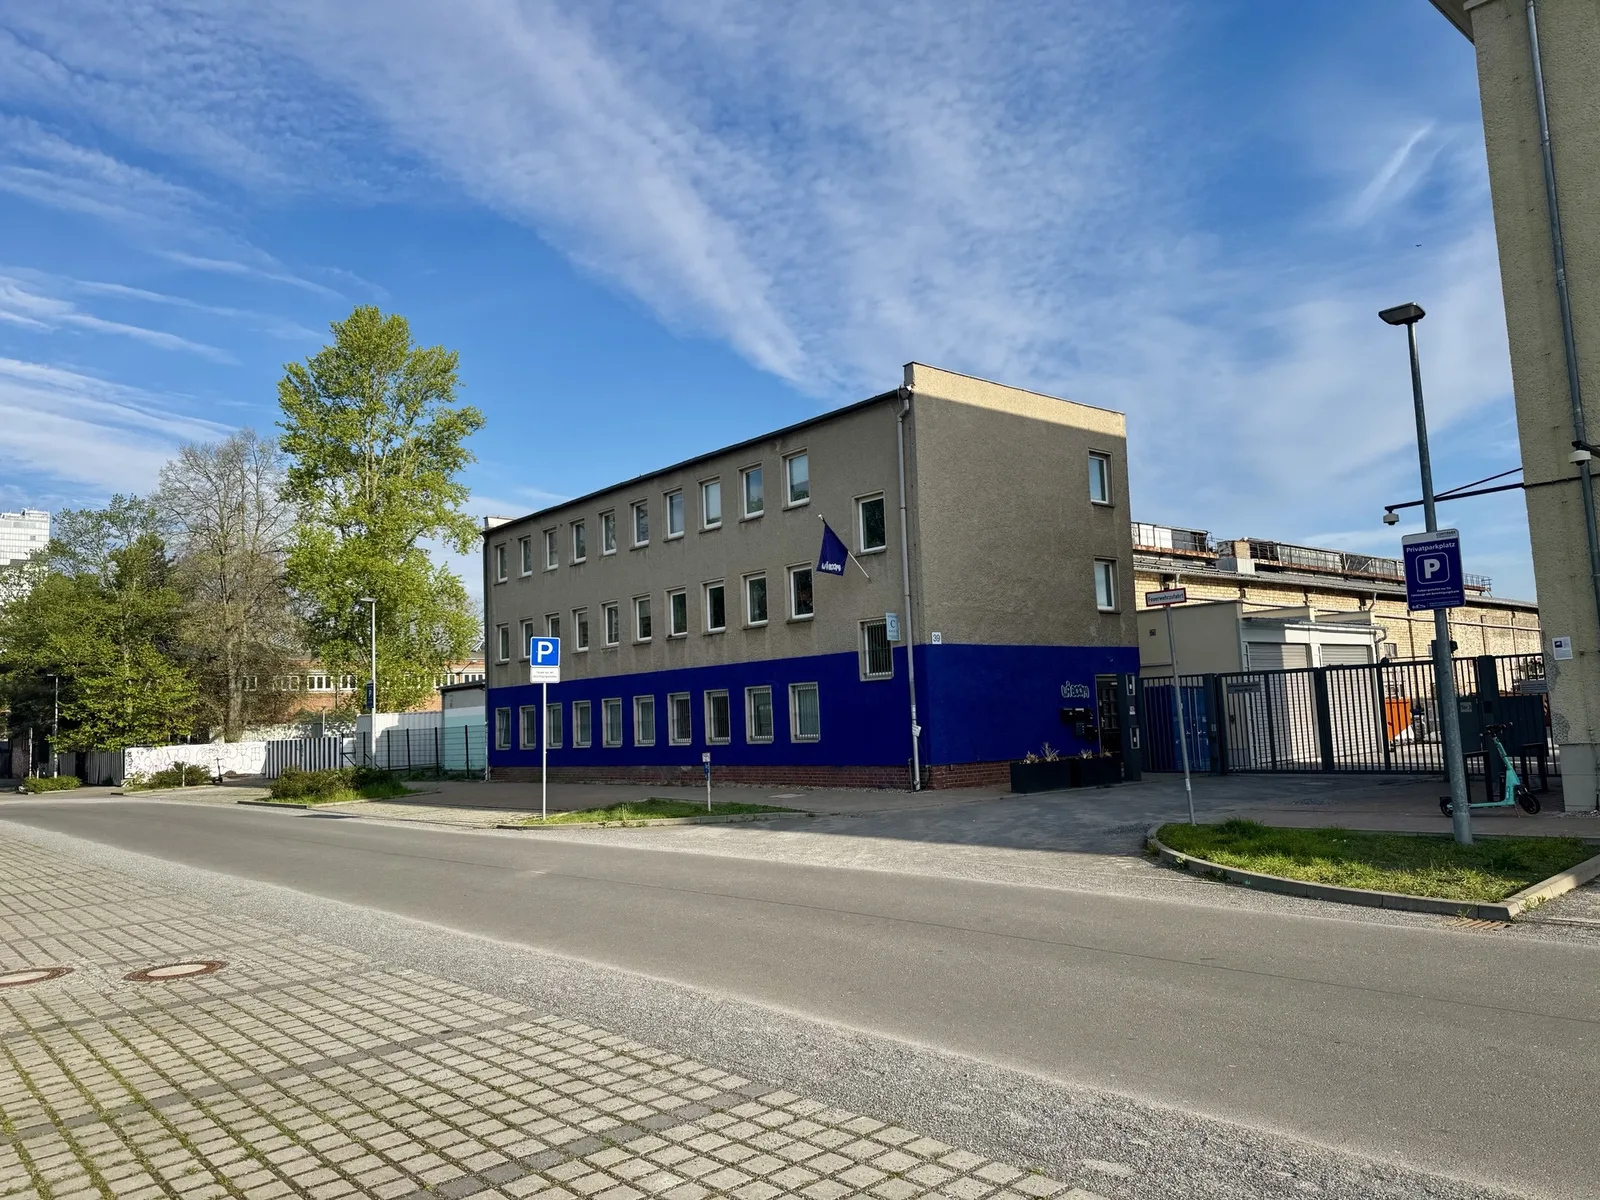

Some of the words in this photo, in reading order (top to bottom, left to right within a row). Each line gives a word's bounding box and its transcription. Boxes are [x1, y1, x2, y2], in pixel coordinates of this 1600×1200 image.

[1406, 542, 1456, 553] Privatparkplatz
[1423, 558, 1441, 579] P
[1148, 593, 1184, 602] Feuerwehrzufahrt
[933, 634, 941, 642] 39
[537, 641, 553, 663] P
